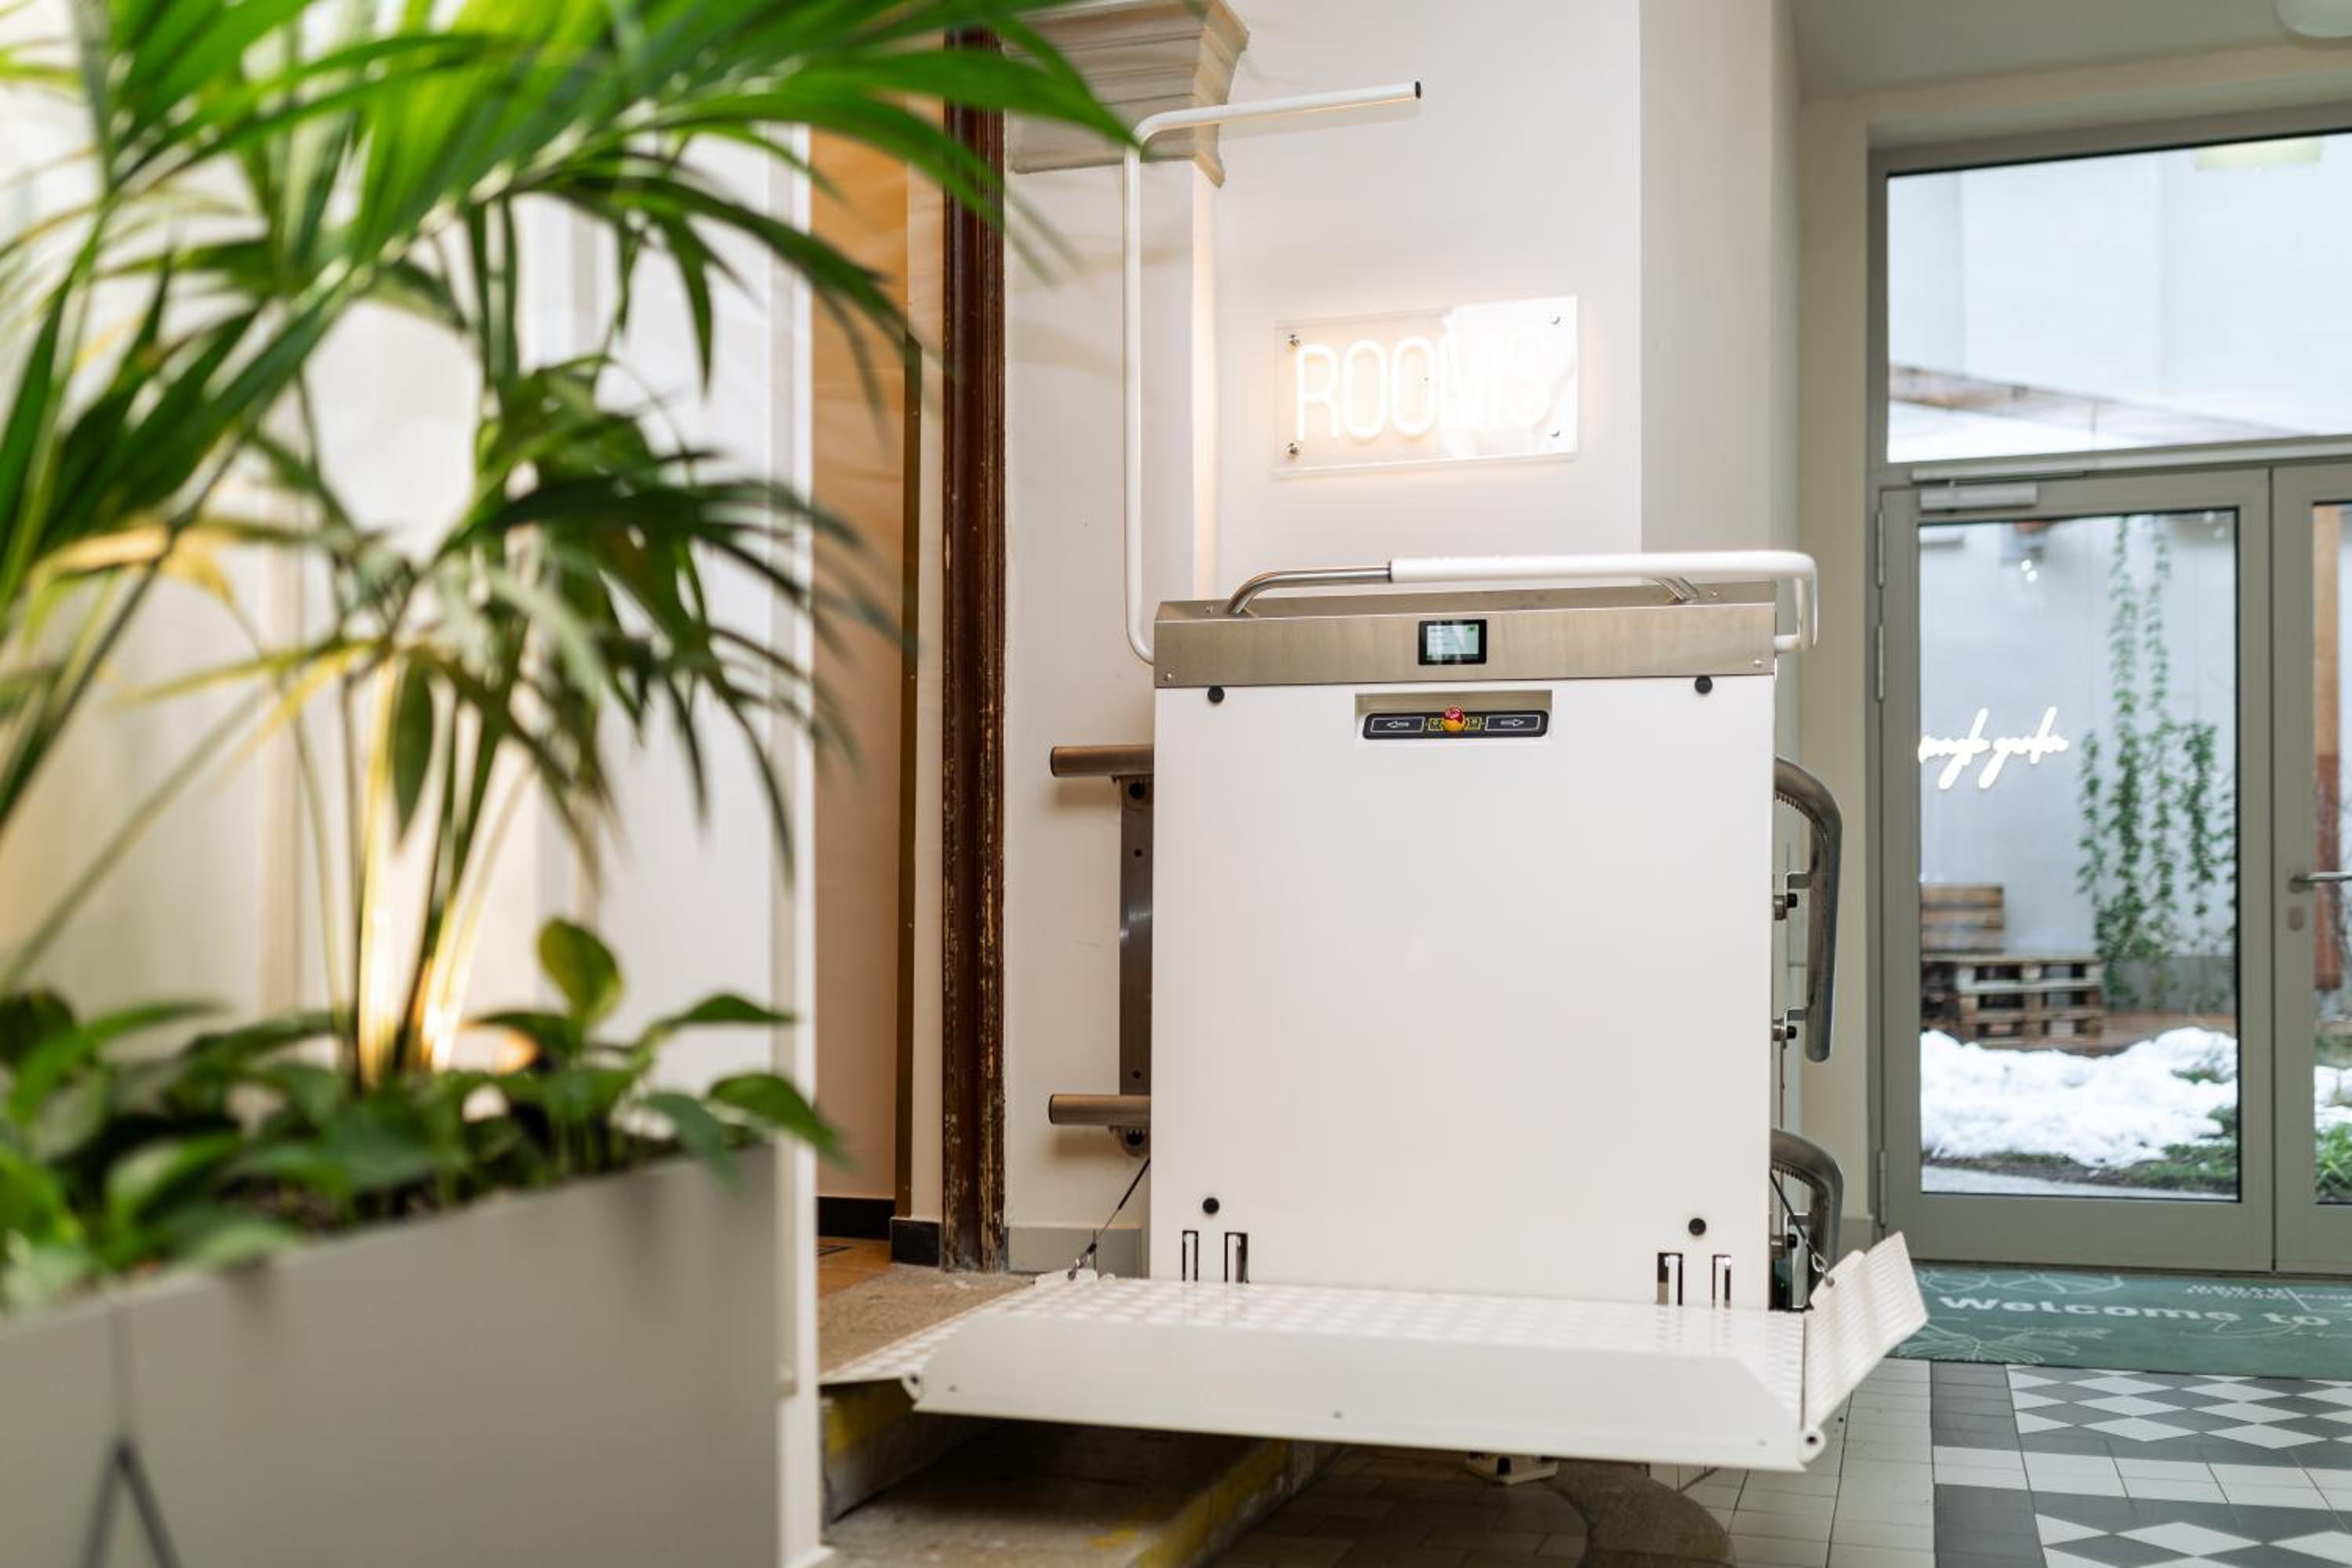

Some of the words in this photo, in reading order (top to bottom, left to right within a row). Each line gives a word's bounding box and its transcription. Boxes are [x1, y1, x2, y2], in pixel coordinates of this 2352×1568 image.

[1296, 326, 1553, 441] ROOMS
[1938, 1296, 2241, 1321] Welcome
[2260, 1312, 2332, 1327] to
